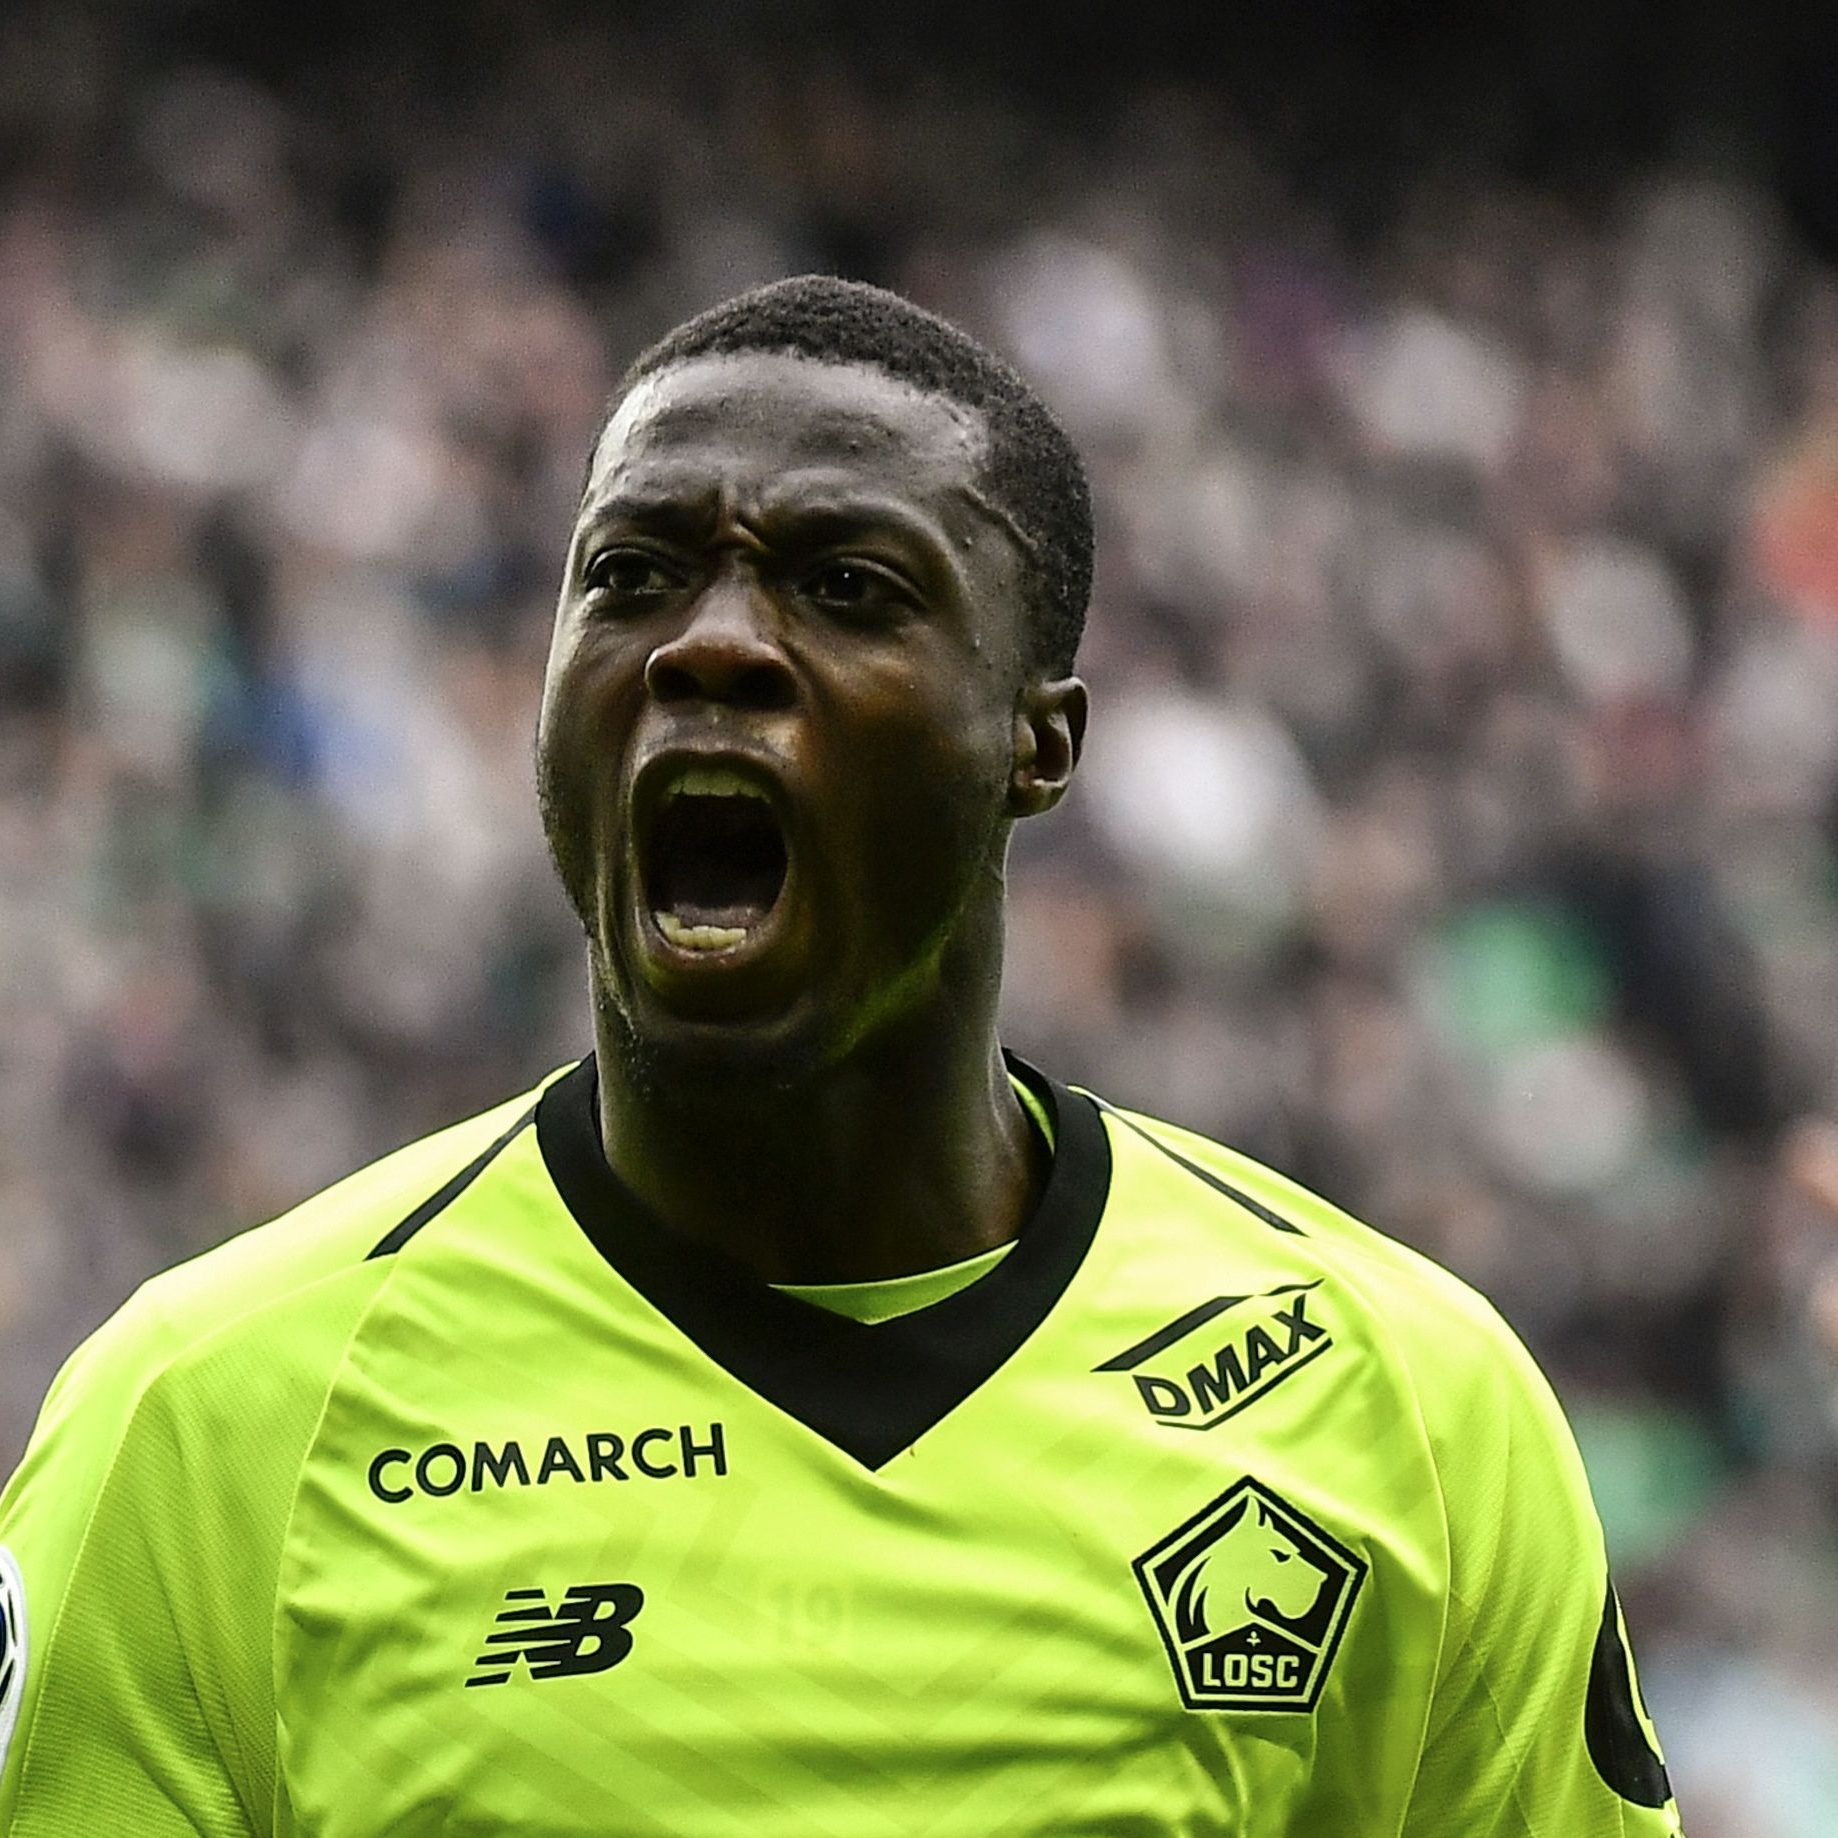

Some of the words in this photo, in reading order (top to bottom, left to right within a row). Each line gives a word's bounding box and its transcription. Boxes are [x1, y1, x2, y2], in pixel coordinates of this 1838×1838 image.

[1131, 1293, 1327, 1417] DMAX
[368, 1422, 728, 1504] COMARCH
[464, 1583, 645, 1688] NB
[1202, 1652, 1300, 1689] LOSC
